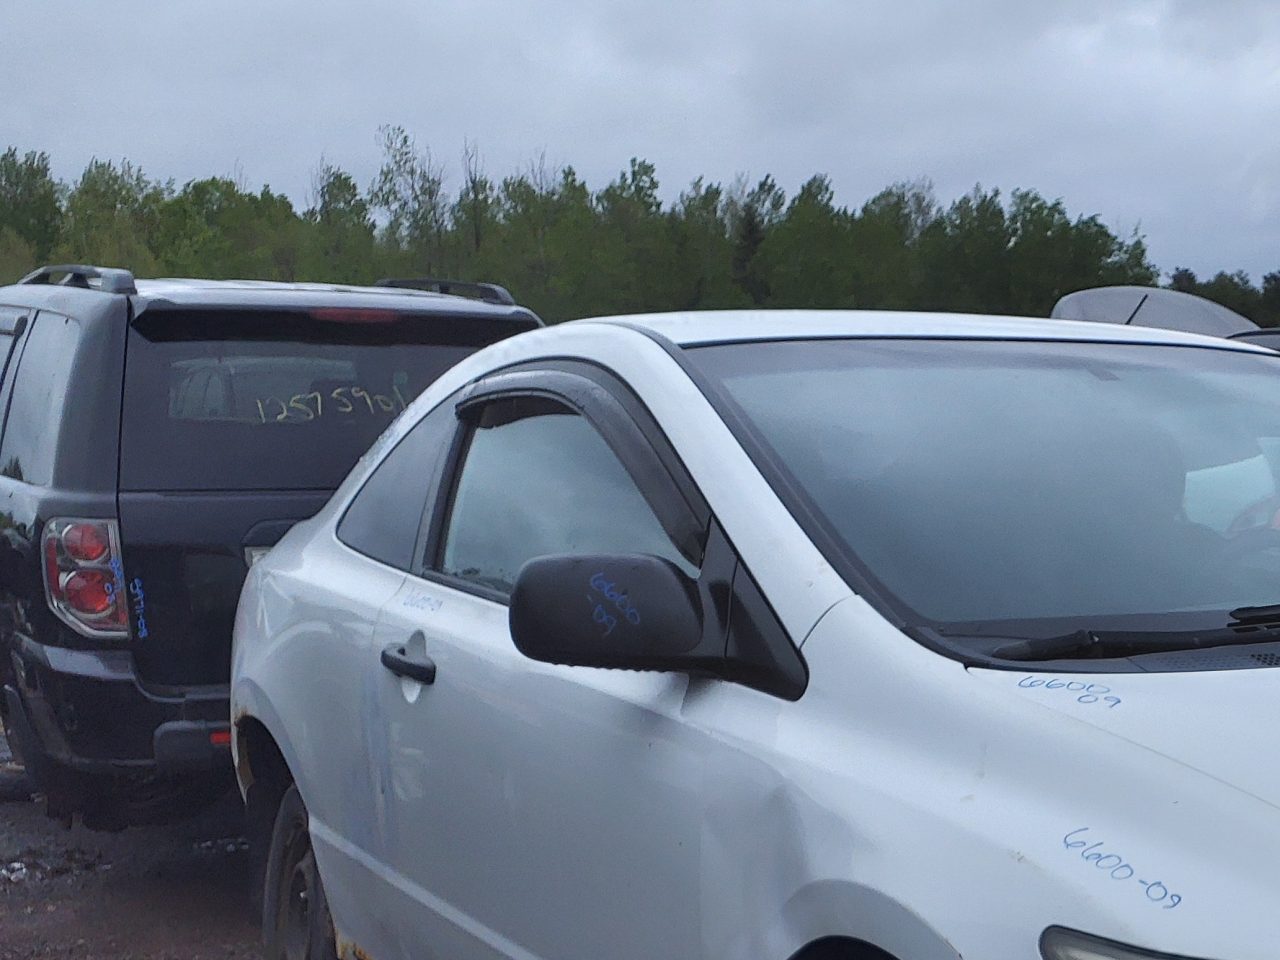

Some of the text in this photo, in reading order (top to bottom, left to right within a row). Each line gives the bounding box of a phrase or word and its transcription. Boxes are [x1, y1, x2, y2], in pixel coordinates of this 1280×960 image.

[1018, 675, 1110, 694] 6600
[1077, 693, 1122, 709] 09
[1063, 827, 1182, 909] 6600-09
